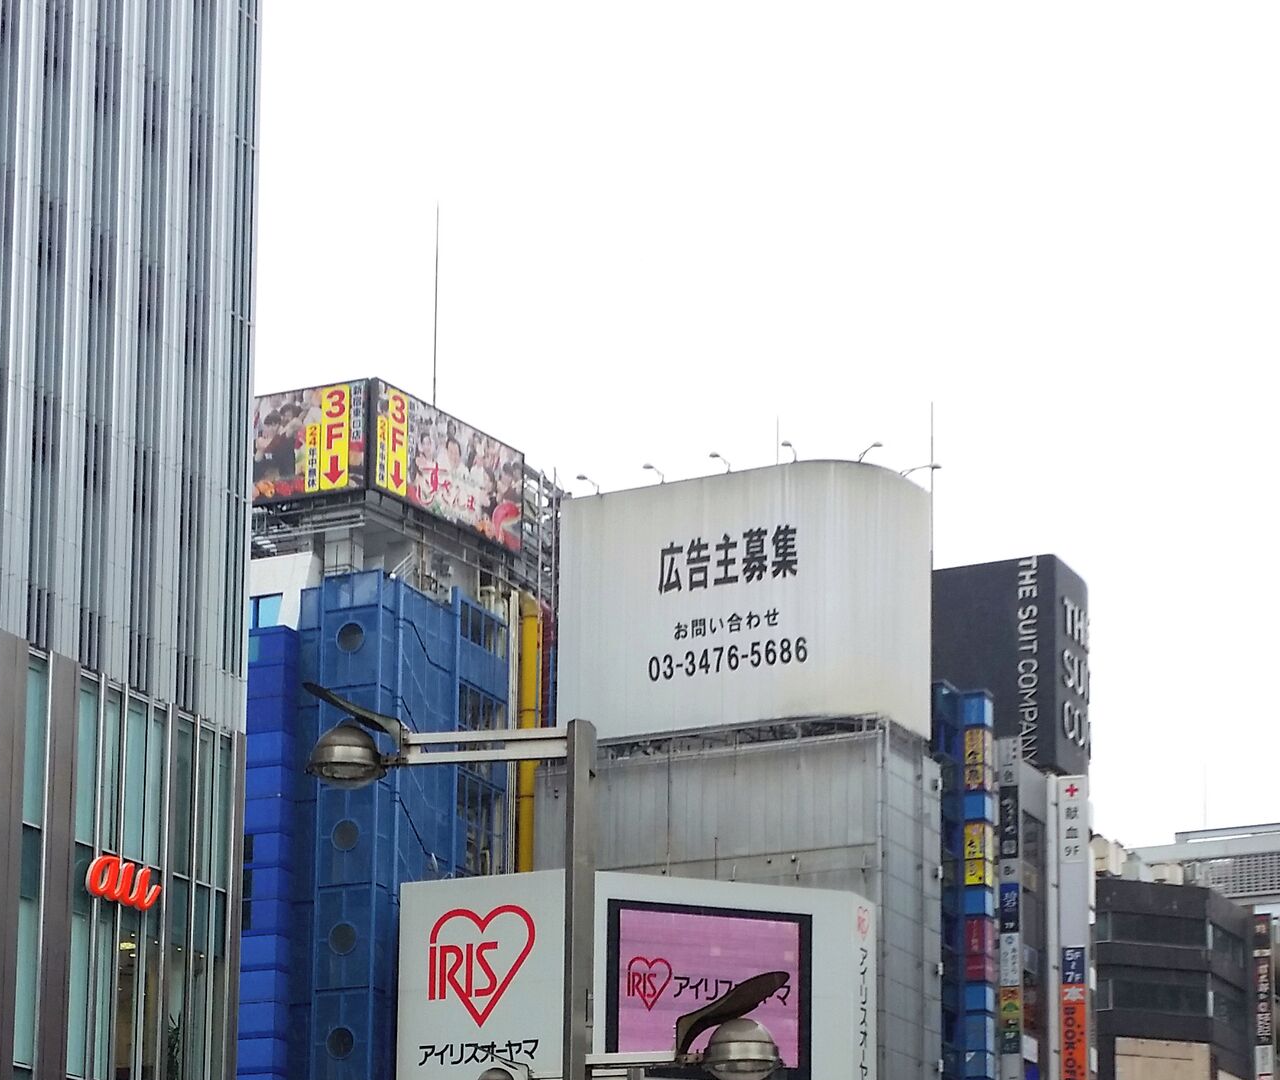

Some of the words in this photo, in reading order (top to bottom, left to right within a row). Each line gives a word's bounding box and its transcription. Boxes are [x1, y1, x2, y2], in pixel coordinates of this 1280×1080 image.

[325, 389, 346, 450] 3F
[658, 525, 799, 595] 広告主募集
[1018, 555, 1038, 600] THE
[673, 607, 780, 641] お問い合わせ
[1017, 604, 1039, 654] SUIT
[648, 637, 809, 682] 03-3476-5686
[1064, 845, 1080, 857] 9F
[85, 855, 162, 912] au
[428, 940, 501, 1001] IRIS
[626, 971, 659, 997] IRIS
[418, 1038, 540, 1067] アイリスオーヤマ
